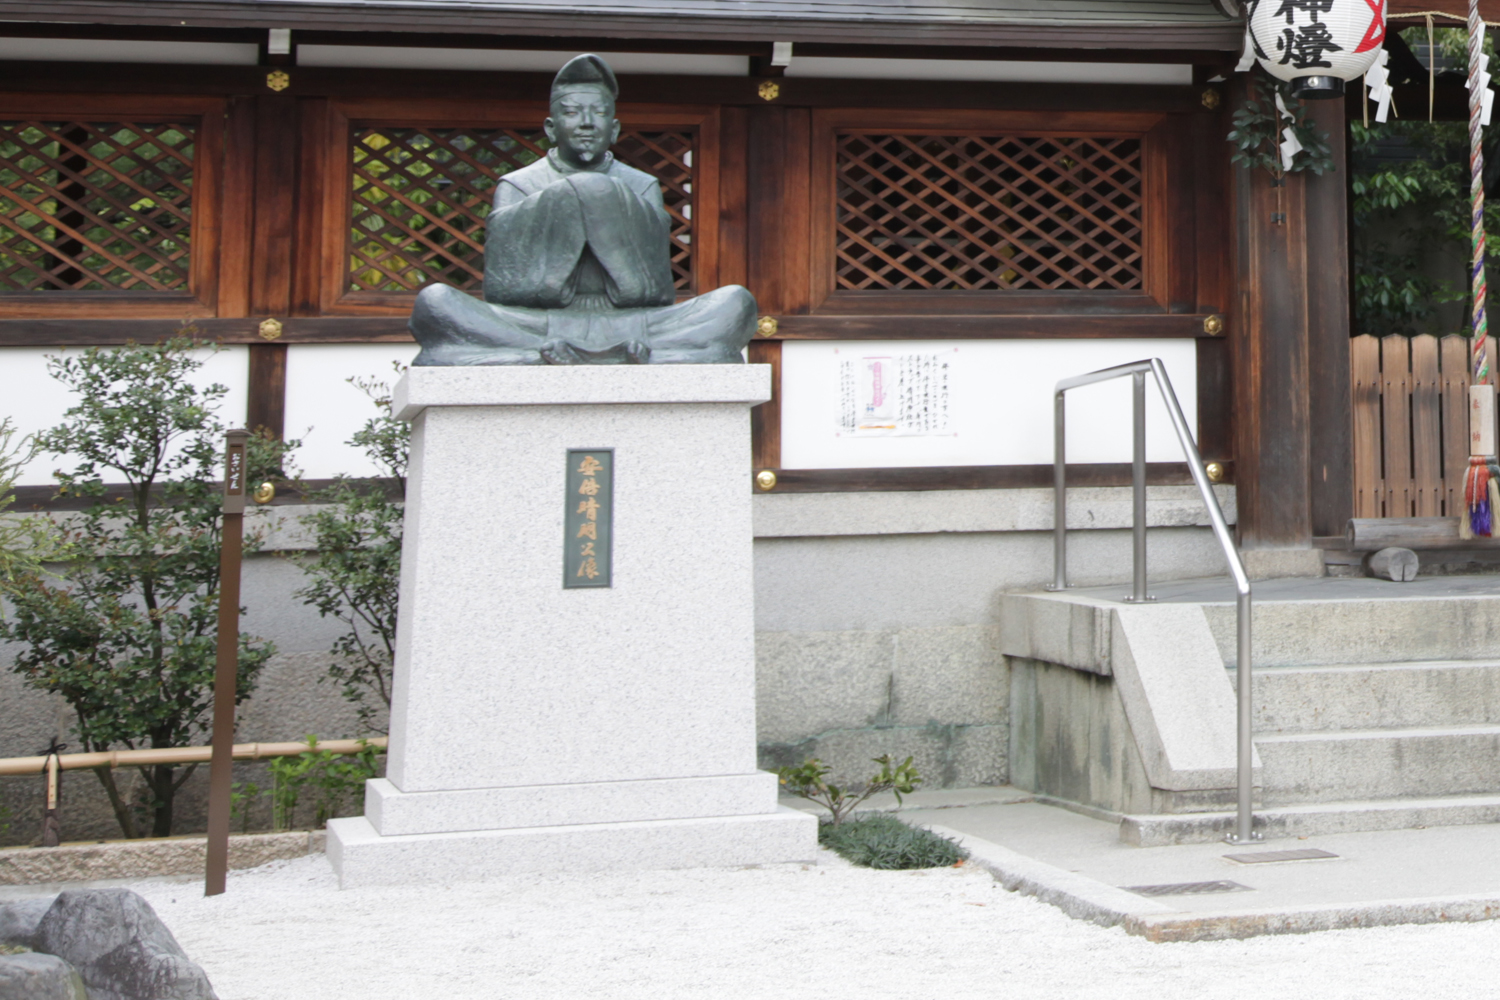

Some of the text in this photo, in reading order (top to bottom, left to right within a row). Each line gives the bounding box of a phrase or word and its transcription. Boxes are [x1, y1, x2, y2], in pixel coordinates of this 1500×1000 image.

[230, 452, 241, 489] おさいせん
[576, 455, 604, 580] 安倍晴明公像
